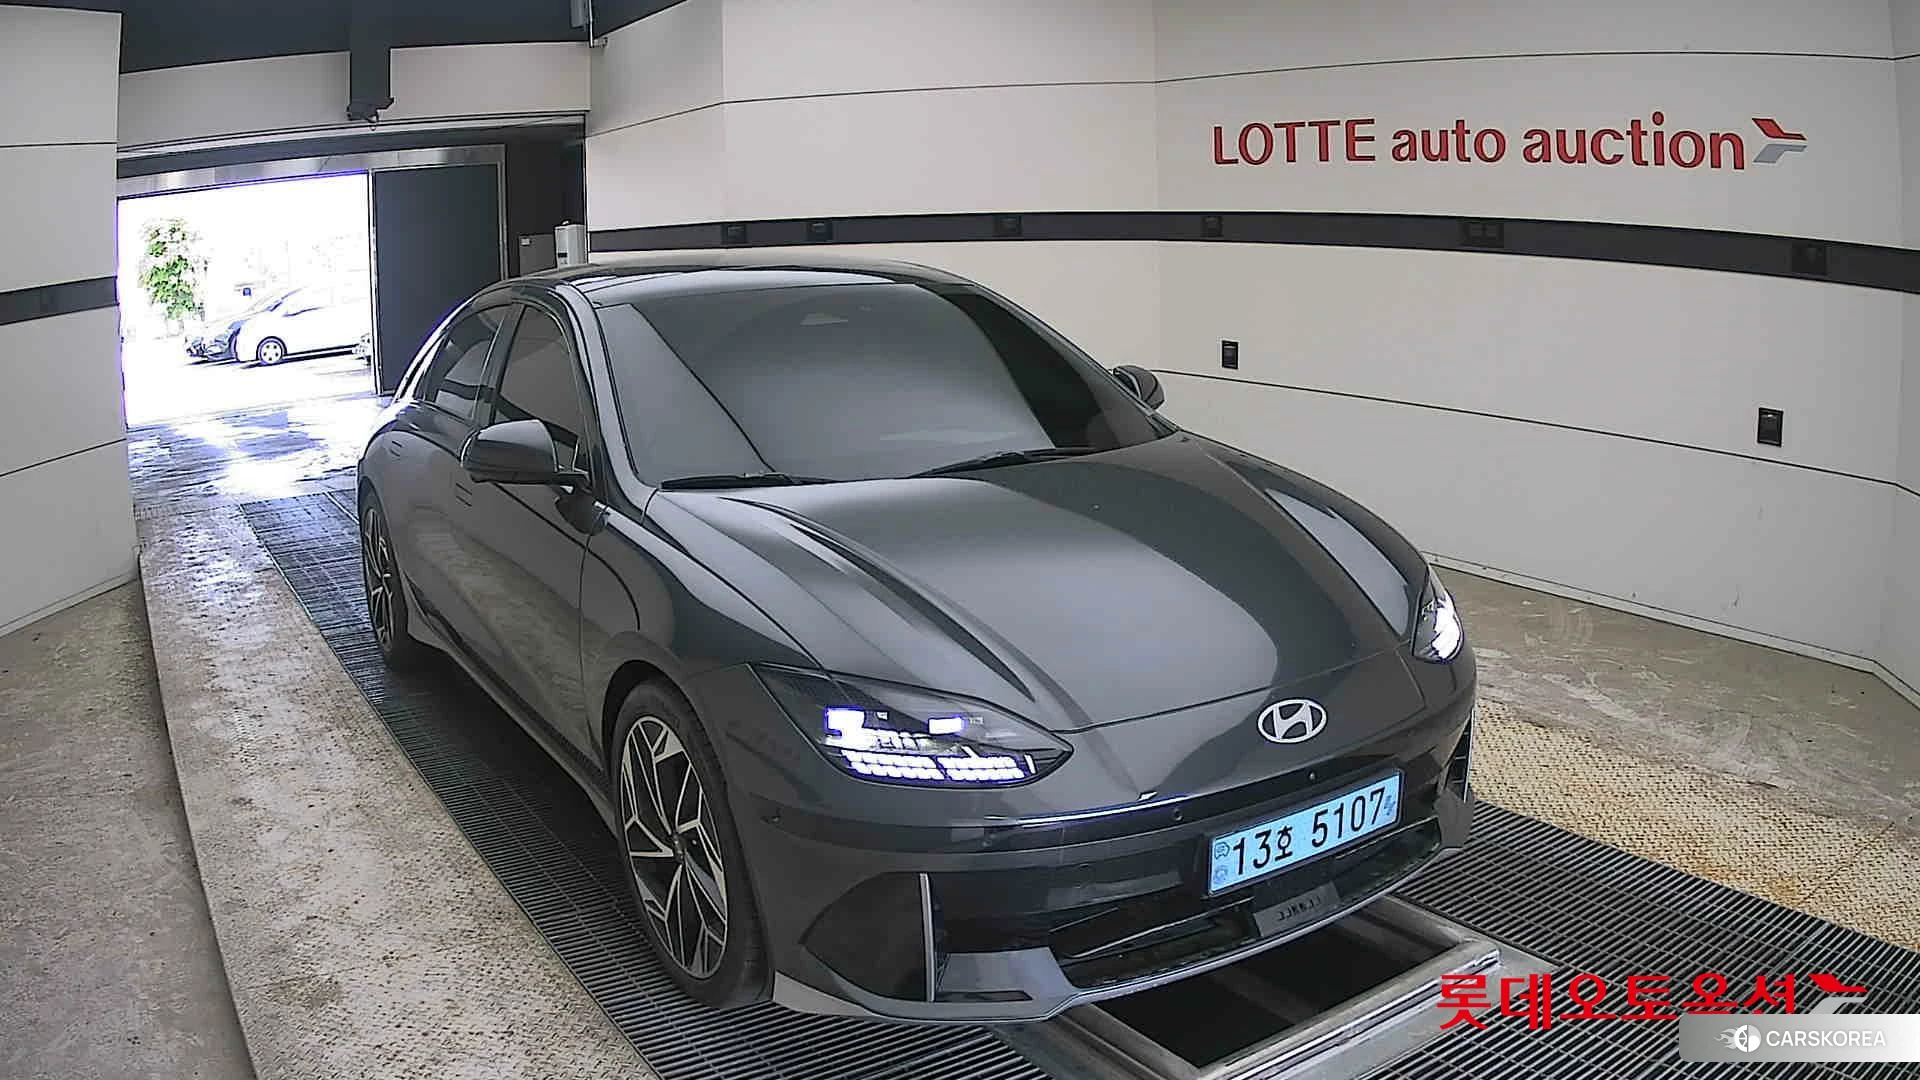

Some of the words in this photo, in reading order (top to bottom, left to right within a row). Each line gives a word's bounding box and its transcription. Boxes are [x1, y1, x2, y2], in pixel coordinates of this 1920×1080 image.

[1213, 119, 1376, 165] LOTTE
[1392, 119, 1506, 163] auto
[1523, 111, 1745, 170] auction
[1232, 825, 1293, 875] 13호
[1311, 787, 1386, 848] 5107
